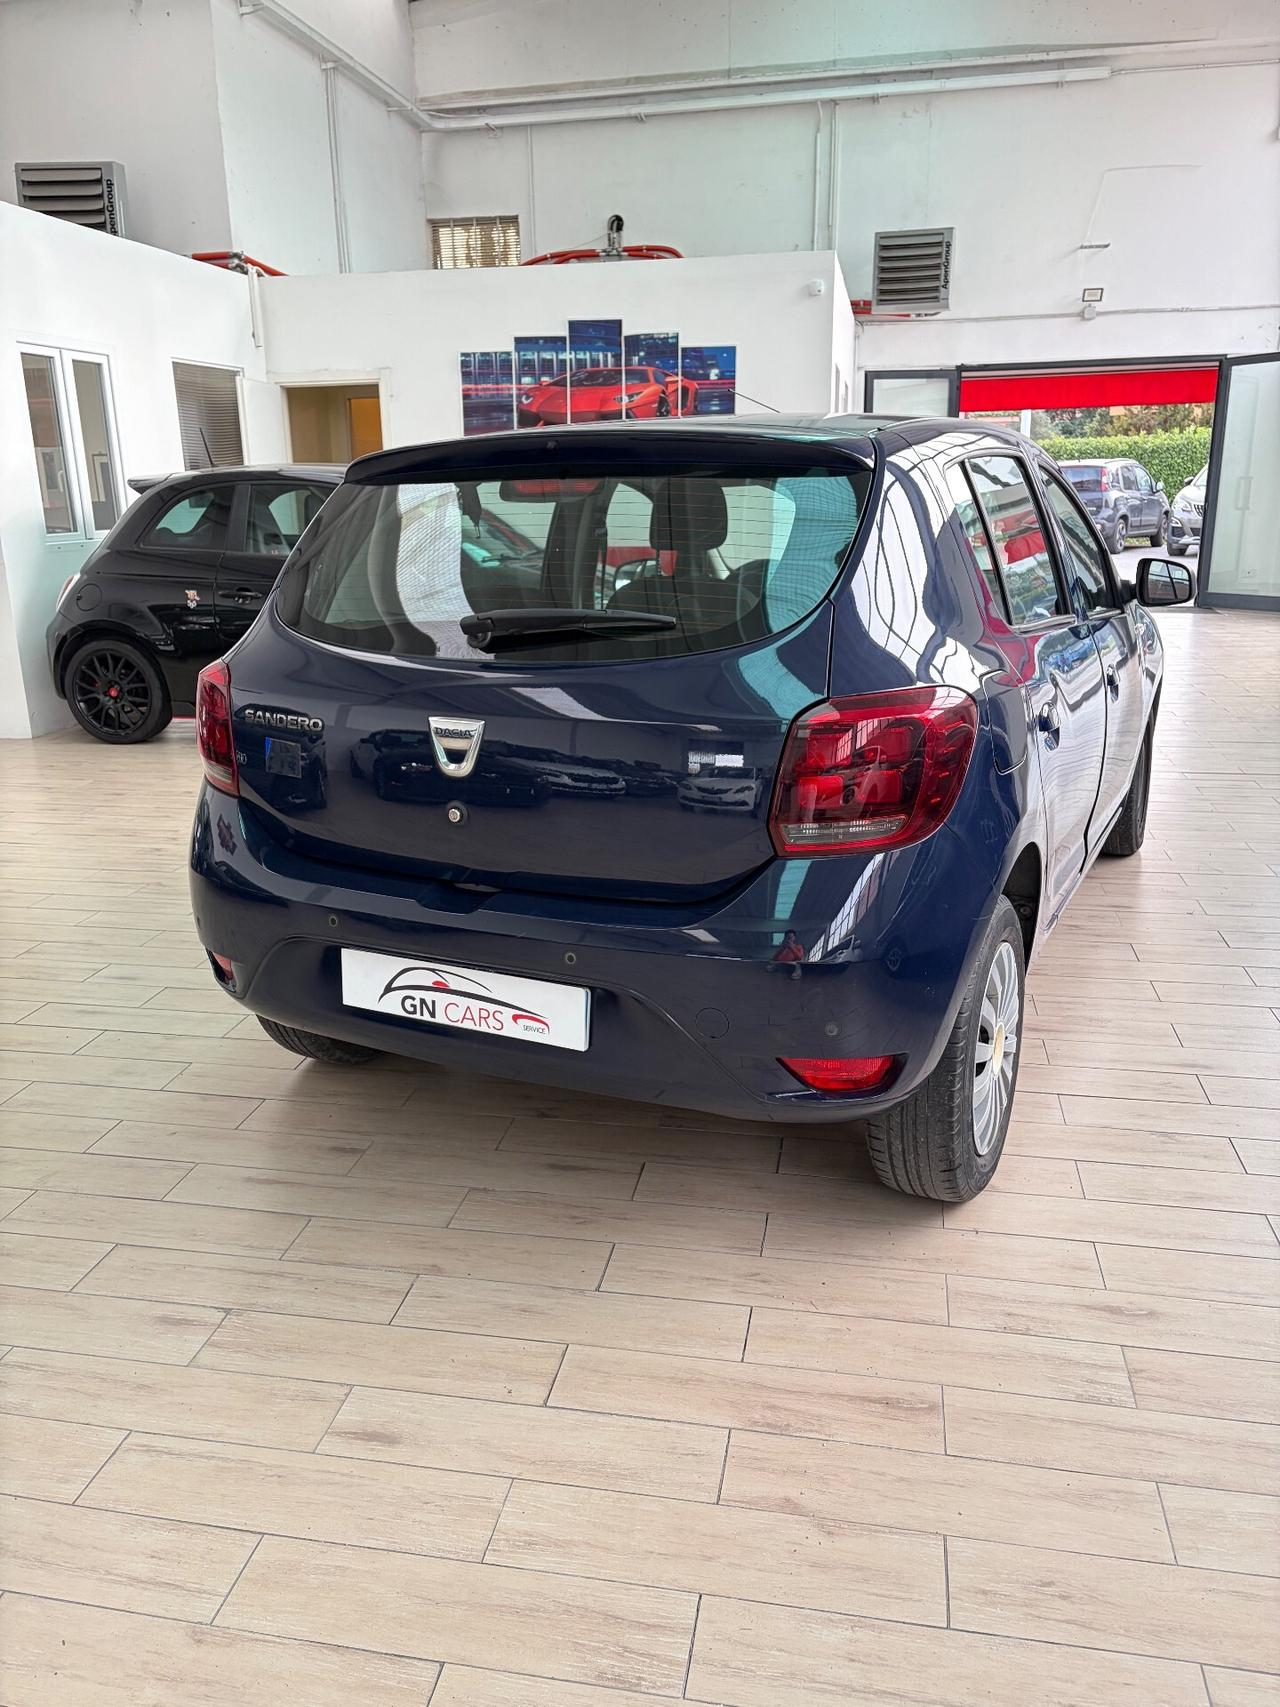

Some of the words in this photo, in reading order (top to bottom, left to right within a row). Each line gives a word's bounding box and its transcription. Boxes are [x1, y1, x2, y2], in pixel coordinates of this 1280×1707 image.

[106, 178, 118, 237] penGroup
[941, 240, 952, 290] ApenGroup
[244, 708, 323, 732] SANDERO
[434, 726, 473, 739] DACIA
[400, 994, 437, 1020] GN
[444, 1001, 505, 1032] CARS
[522, 1024, 547, 1035] SERVICE
